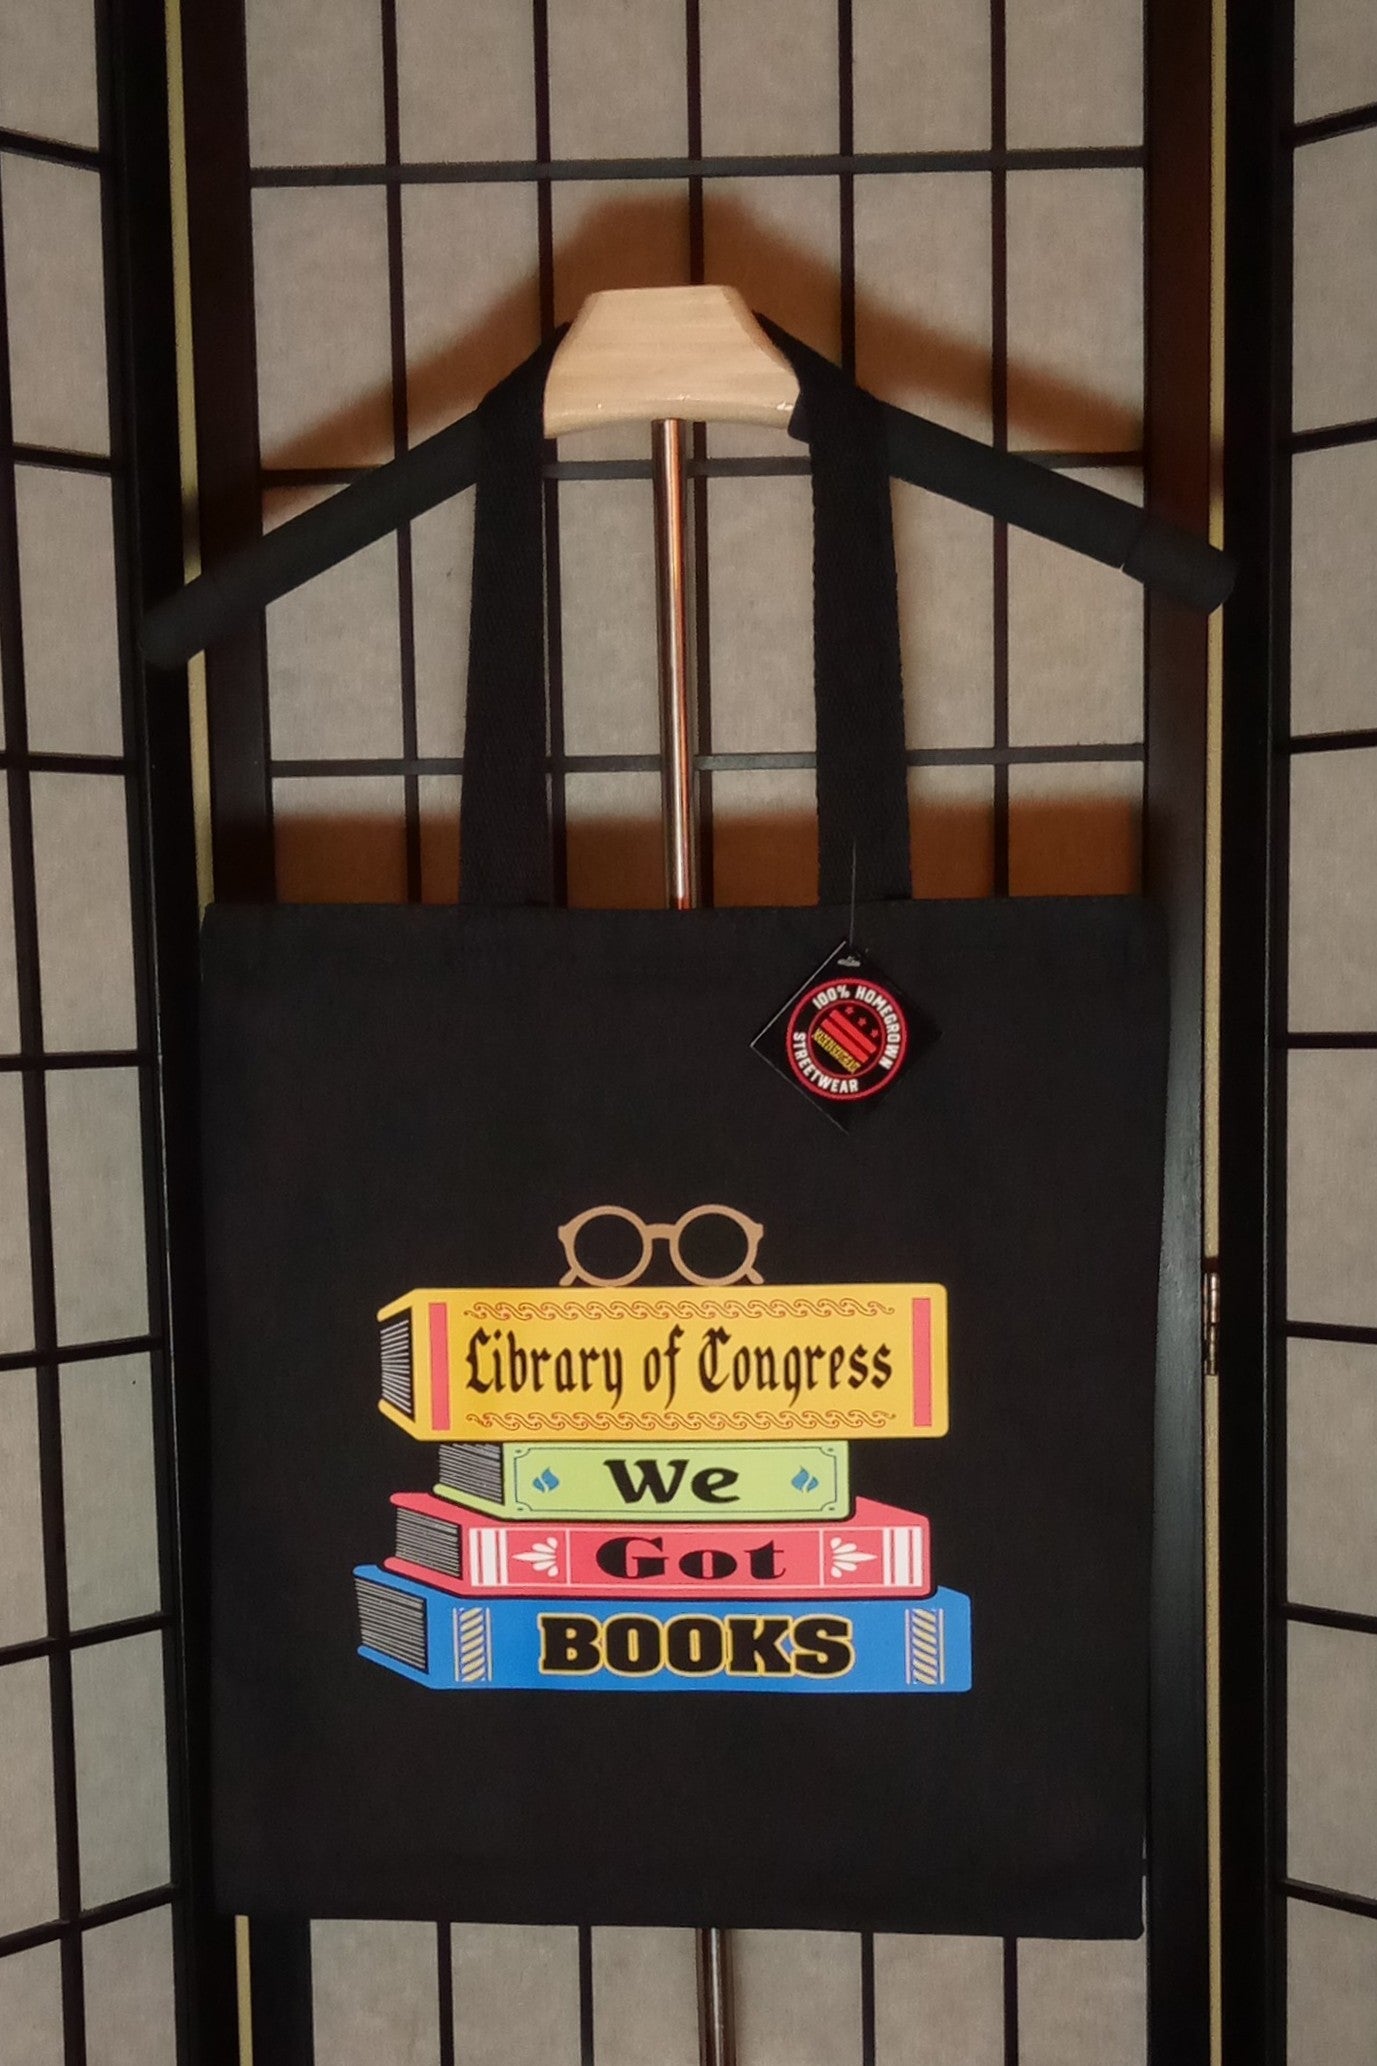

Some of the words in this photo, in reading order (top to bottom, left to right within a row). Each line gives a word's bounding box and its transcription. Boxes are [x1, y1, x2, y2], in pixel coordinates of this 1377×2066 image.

[812, 985, 850, 1010] 100%
[855, 985, 901, 1070] HOMEGROWN
[793, 1032, 859, 1093] STREETWEAR
[465, 1326, 623, 1409] Library
[643, 1324, 685, 1409] of
[699, 1326, 893, 1408] Congress
[603, 1459, 740, 1504] We
[596, 1536, 787, 1580] Got
[538, 1613, 855, 1678] BOOKS
